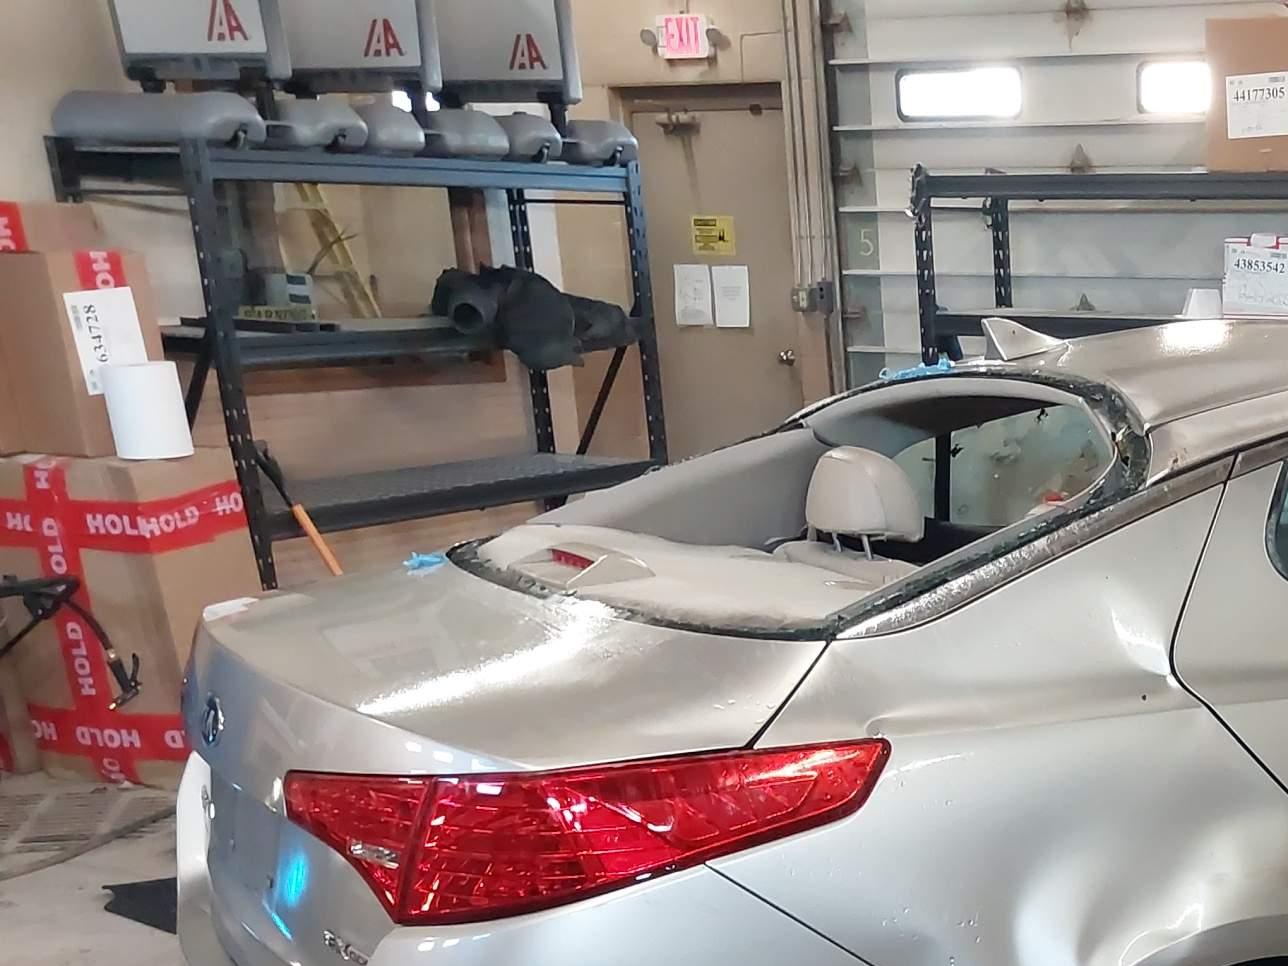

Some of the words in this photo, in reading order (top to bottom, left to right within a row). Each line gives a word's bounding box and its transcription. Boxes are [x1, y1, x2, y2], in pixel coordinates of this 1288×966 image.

[664, 16, 700, 54] EXIT
[1232, 87, 1286, 101] 44177305
[860, 229, 874, 256] 5
[1234, 259, 1286, 274] 43853542
[43, 518, 67, 574] OLD
[66, 621, 96, 695] HOLD
[75, 726, 141, 748] HOLD
